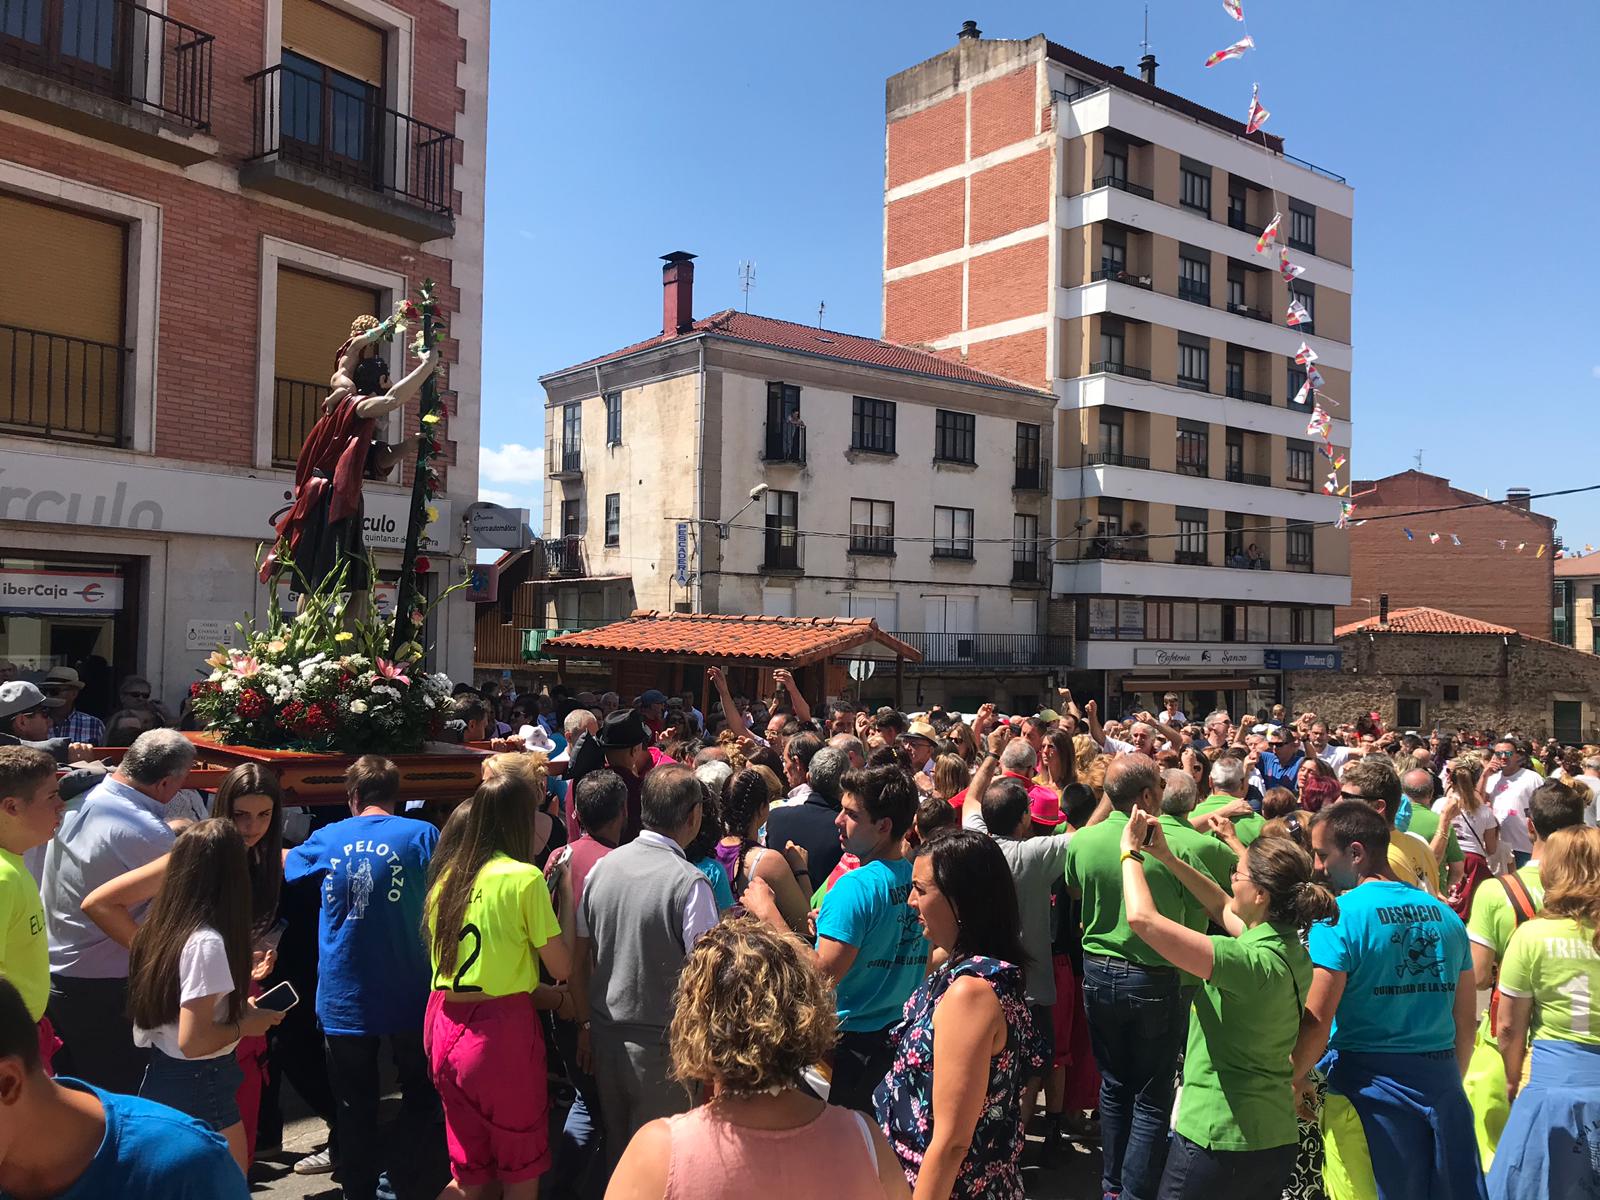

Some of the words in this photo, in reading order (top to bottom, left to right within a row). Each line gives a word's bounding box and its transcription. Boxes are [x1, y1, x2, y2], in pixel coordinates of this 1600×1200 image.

[3, 583, 68, 599] iberCaja
[1304, 655, 1326, 666] Allianz
[343, 840, 405, 903] PELOTAZO
[1428, 982, 1441, 994] LA
